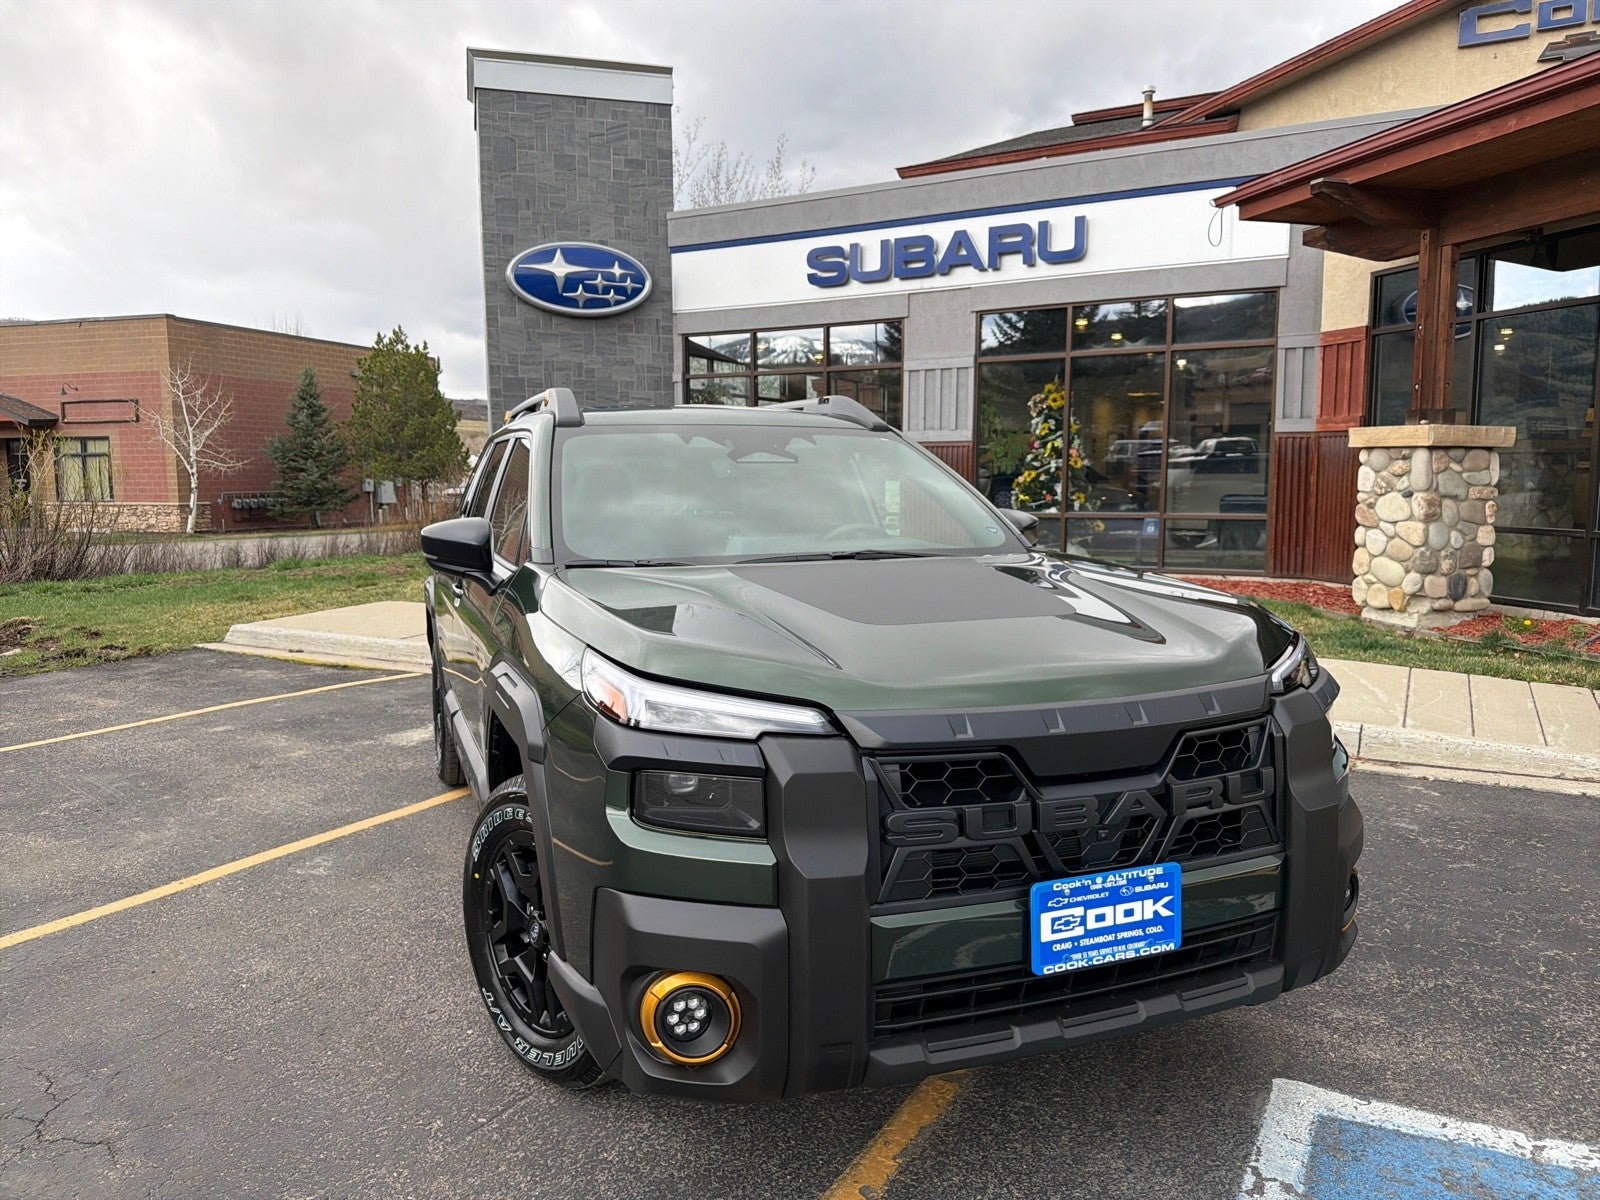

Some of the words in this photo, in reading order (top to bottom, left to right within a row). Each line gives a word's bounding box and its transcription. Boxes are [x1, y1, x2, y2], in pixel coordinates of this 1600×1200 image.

[1458, 0, 1600, 49] CO
[806, 215, 1088, 287] SUBARU
[885, 767, 1274, 846] SUBARU
[472, 807, 533, 861] BRIDGES
[1107, 866, 1164, 882] ALTITUDE
[1134, 881, 1169, 893] SUBARU
[1069, 891, 1110, 902] CHEVROLET
[1052, 941, 1073, 952] CRAIG
[1079, 933, 1116, 946] STEAMBOAT
[1117, 929, 1144, 940] SPRINGS,
[1145, 925, 1164, 934] COLO.
[1043, 942, 1175, 975] COOK-CARS.COM
